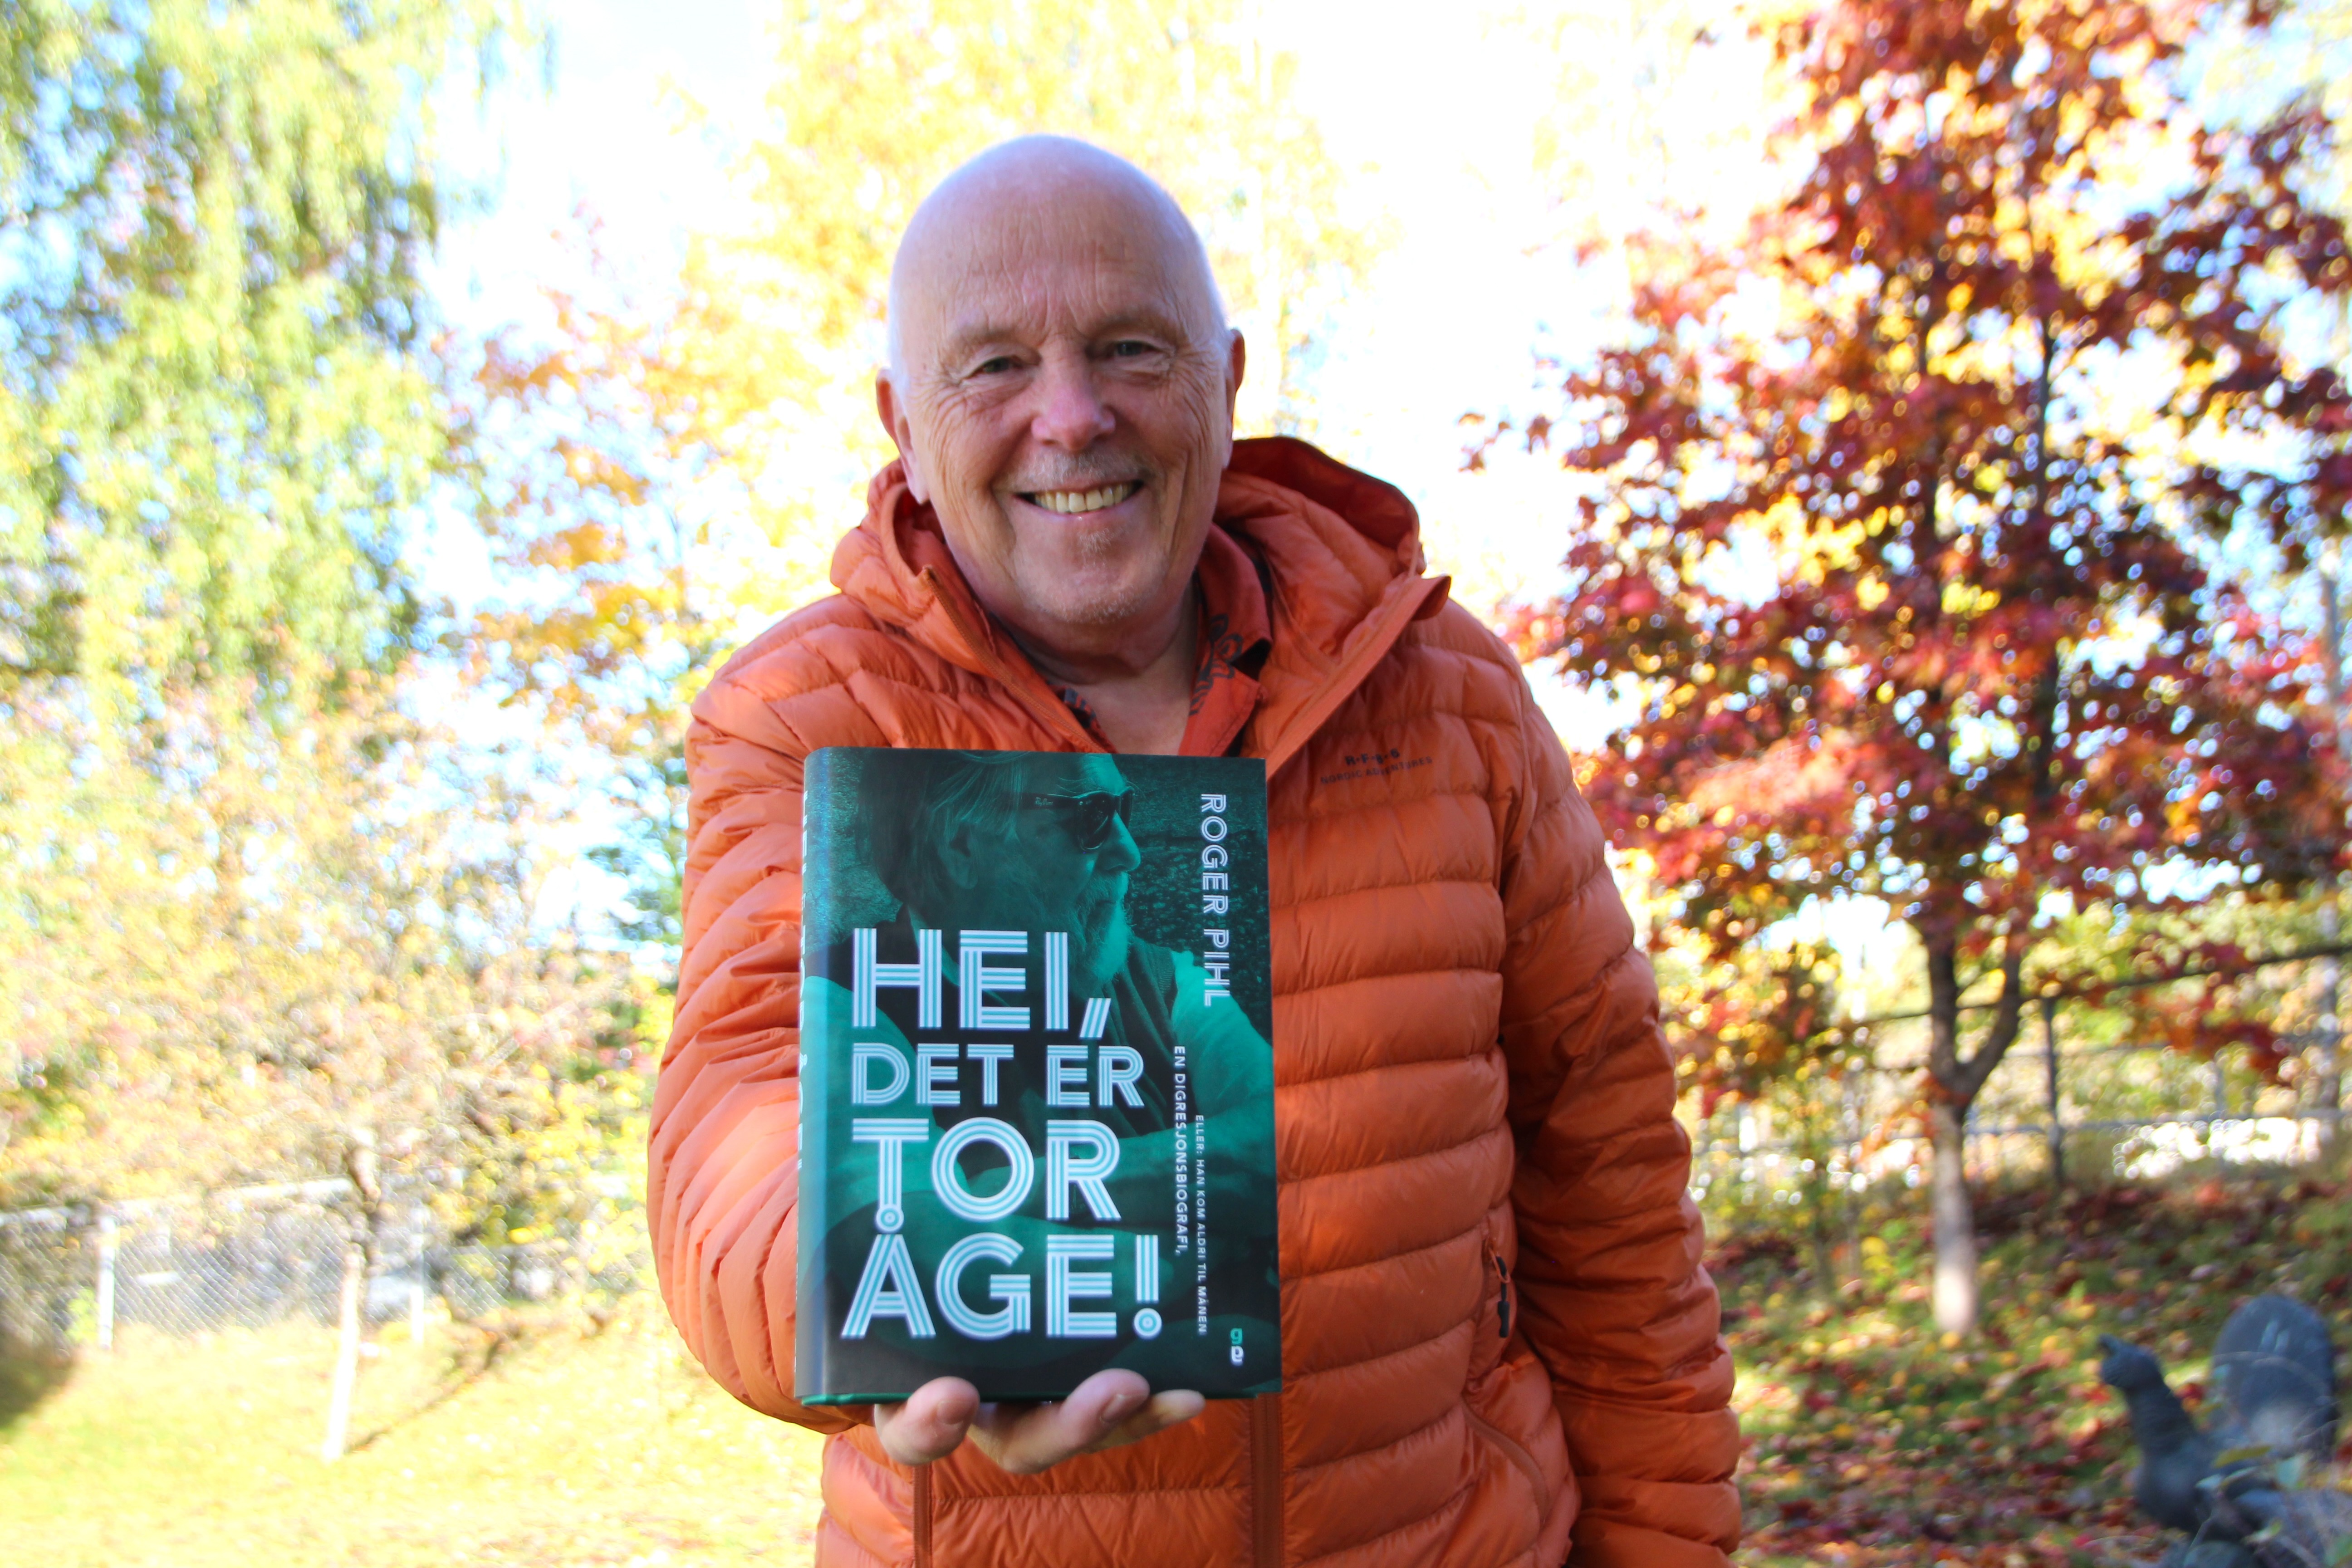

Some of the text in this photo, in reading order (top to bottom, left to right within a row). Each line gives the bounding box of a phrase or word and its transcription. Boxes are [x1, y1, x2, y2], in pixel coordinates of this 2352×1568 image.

[1321, 769, 1363, 784] NORDIC
[1201, 794, 1230, 1006] ROGER PIHL
[853, 928, 1111, 1039] HEI,
[852, 1043, 1145, 1107] DET ER
[852, 1116, 1122, 1221] TOR
[1174, 1045, 1188, 1255] EN DIGRESJONSBIOGRAFI,
[840, 1204, 1162, 1340] ÅGE!
[1196, 1114, 1209, 1336] ELLER: HAN KOM ALDRI TIL MÅNEN
